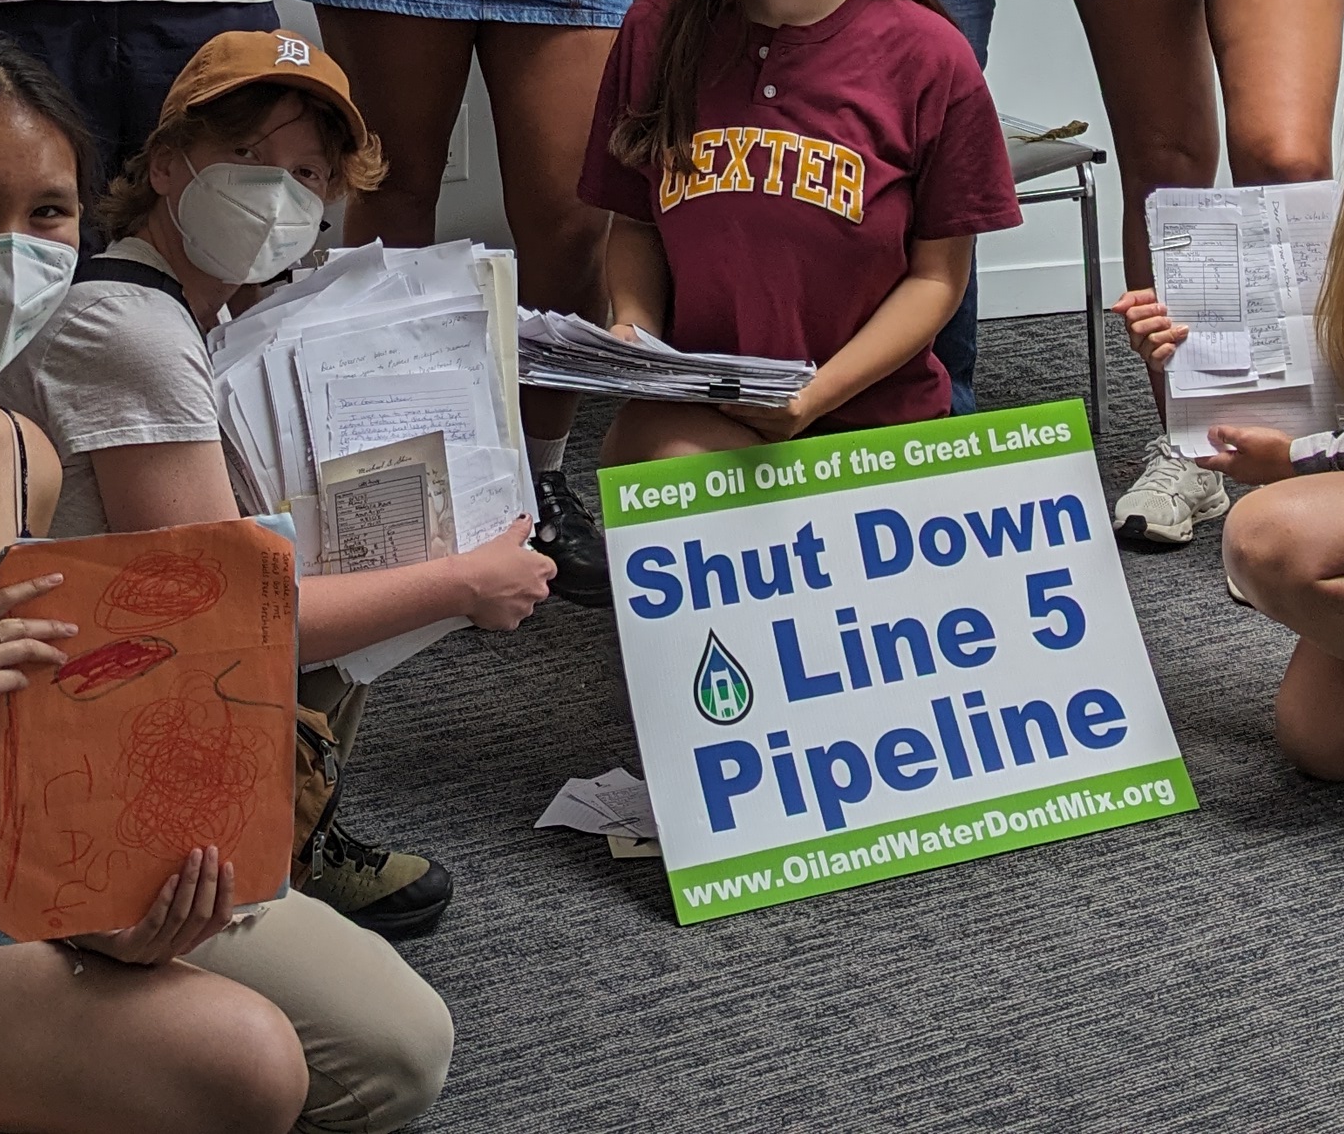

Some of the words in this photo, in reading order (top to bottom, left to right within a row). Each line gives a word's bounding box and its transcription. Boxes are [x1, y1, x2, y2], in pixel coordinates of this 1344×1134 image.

[273, 33, 312, 67] D
[1271, 200, 1279, 223] Dear
[339, 399, 356, 409] Dear
[618, 477, 698, 514] Keep
[704, 468, 746, 498] Oil
[753, 460, 807, 492] Out
[813, 451, 843, 484] of
[849, 448, 897, 475] the
[903, 432, 983, 467] Great
[987, 419, 1073, 453] Lakes
[625, 520, 833, 620] Shut
[854, 492, 1092, 581] Down
[773, 606, 998, 704] Line
[1026, 567, 1088, 651] 5
[693, 687, 1130, 835] Pipeline
[681, 777, 1177, 910] www.OilandWaterDontMix.org
